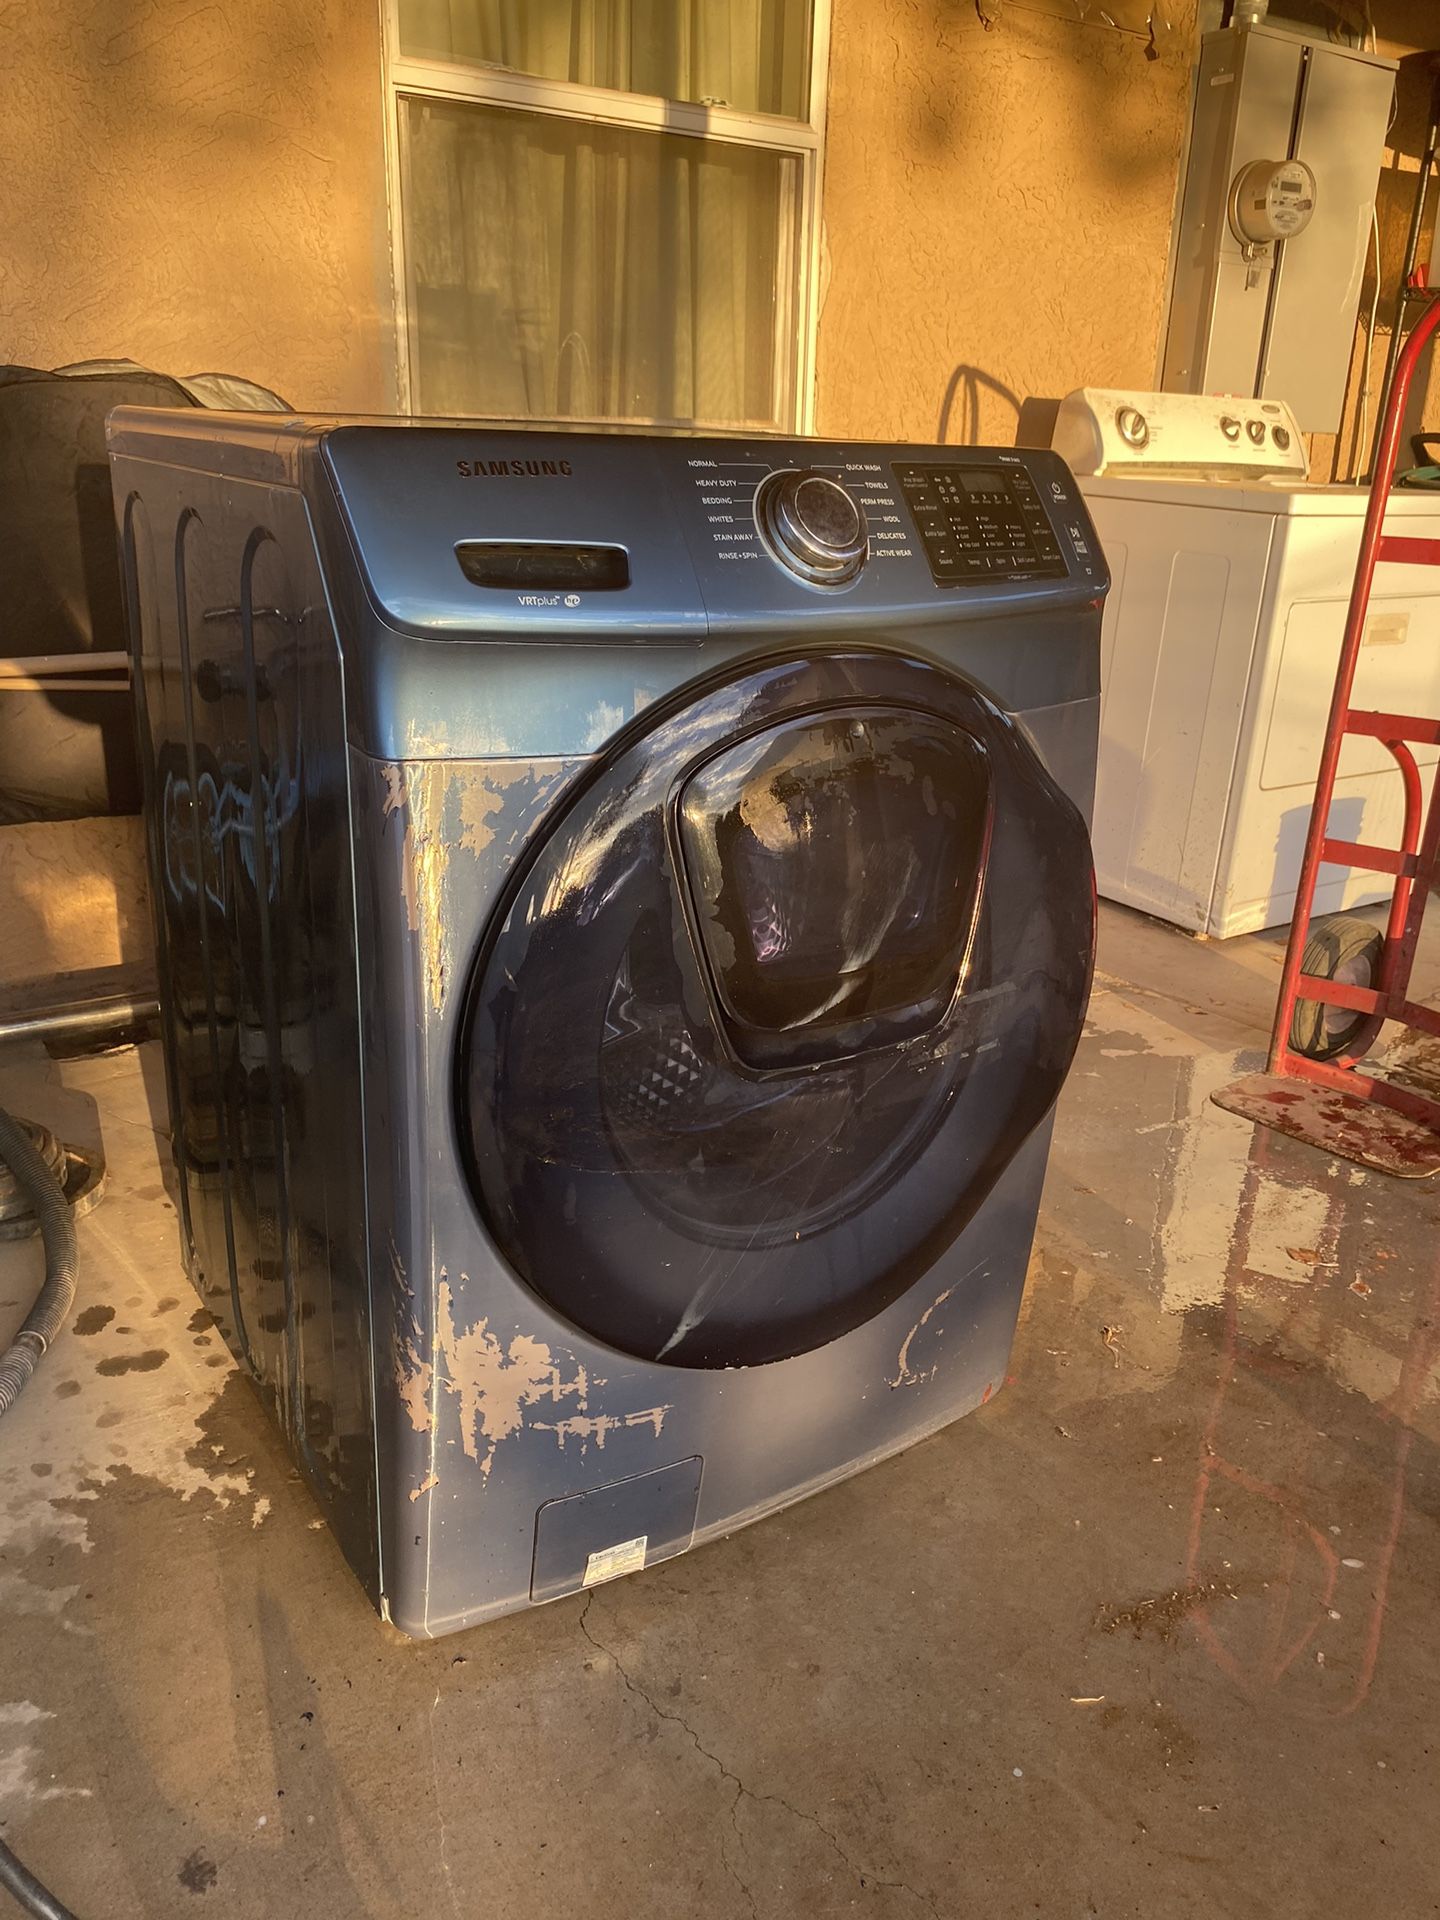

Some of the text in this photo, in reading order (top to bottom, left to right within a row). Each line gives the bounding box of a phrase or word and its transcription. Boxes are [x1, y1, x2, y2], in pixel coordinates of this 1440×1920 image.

[687, 459, 718, 468] NORMAL
[845, 463, 882, 472] QUICK WASH
[456, 460, 574, 478] SAMSUNG
[695, 479, 737, 487] HEAVY DUTY
[864, 481, 889, 490] TOWELS
[701, 497, 733, 505] BEDDING
[860, 498, 895, 506] PERM PRESS
[707, 515, 734, 523] WHITES
[882, 515, 901, 523] WOOL
[712, 533, 753, 542] STAIN AWAY
[876, 532, 906, 540] DELICATES
[876, 549, 913, 558] ACTIVE WEAR
